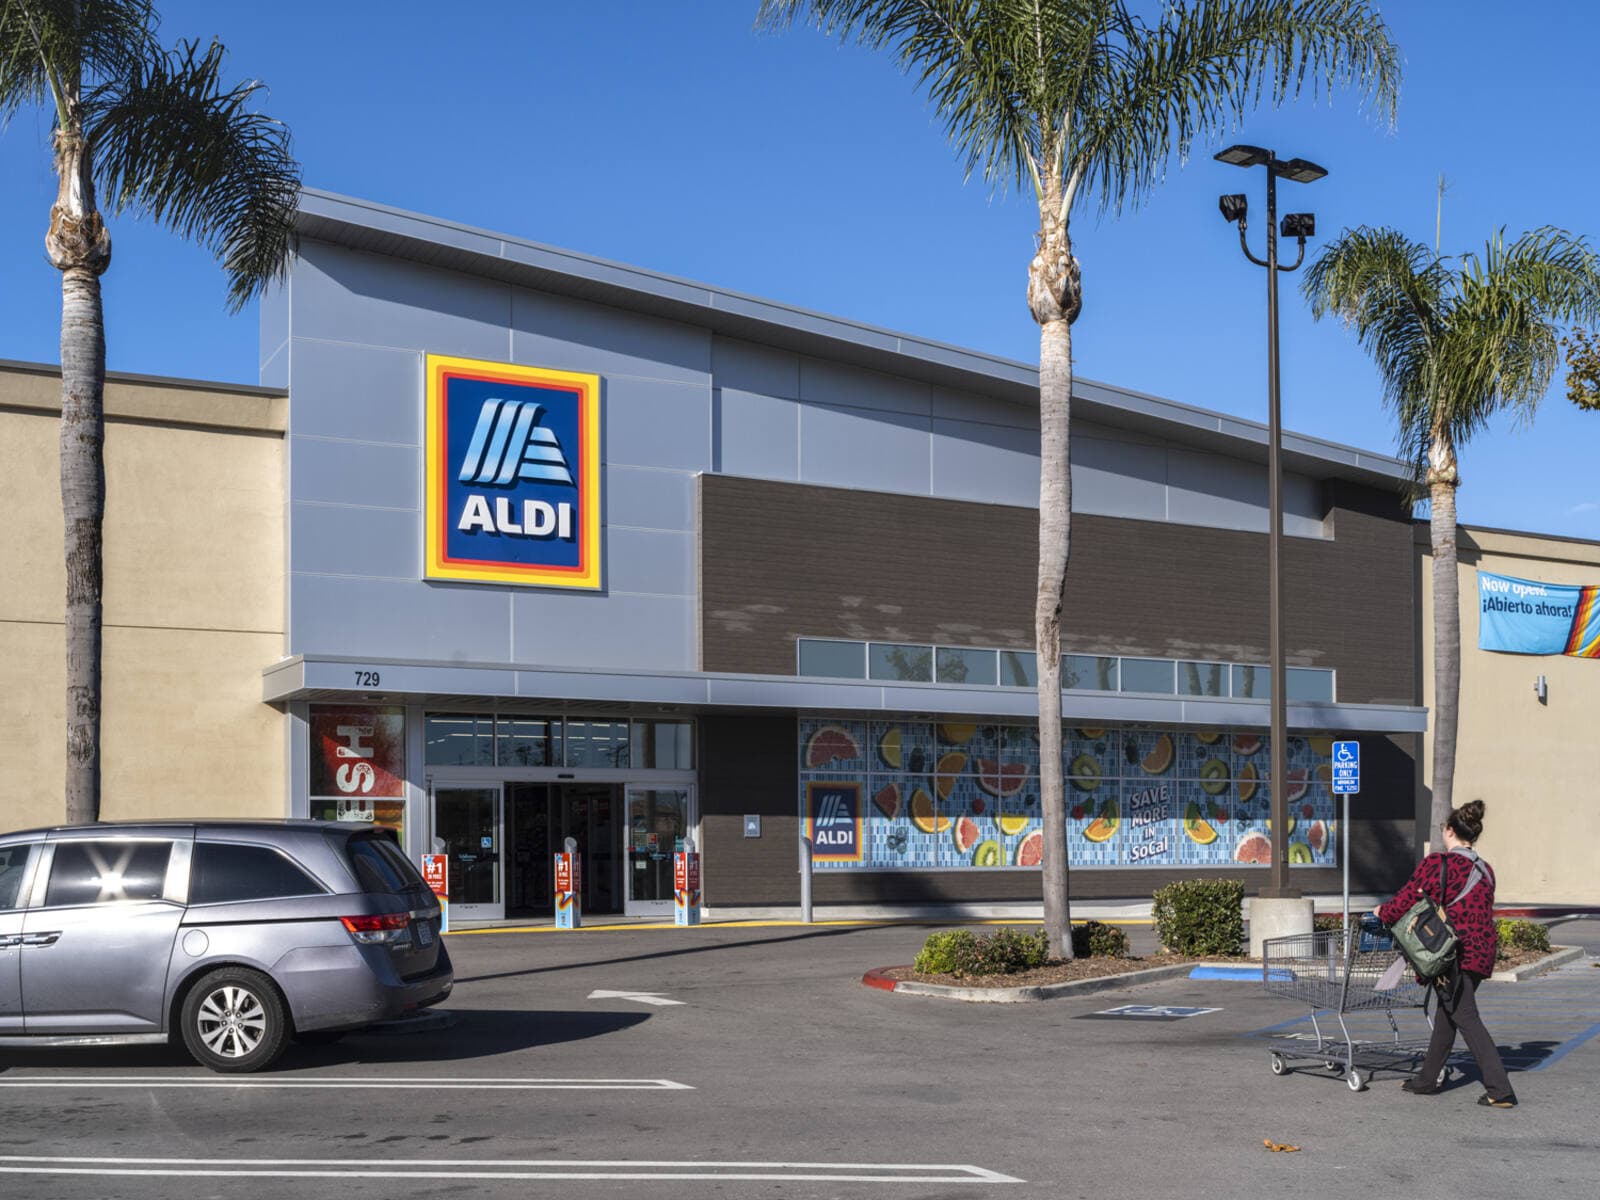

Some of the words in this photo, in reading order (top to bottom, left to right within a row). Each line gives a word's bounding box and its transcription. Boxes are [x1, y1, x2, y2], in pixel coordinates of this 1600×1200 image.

[458, 495, 571, 538] ALDI
[1482, 577, 1509, 592] Now
[1483, 597, 1533, 615] ¡Abierto
[1535, 601, 1573, 618] ahora!
[355, 671, 380, 687] 729
[1334, 761, 1358, 769] PARKING
[1339, 769, 1353, 777] ONLY
[1131, 785, 1168, 809] SAVE
[1131, 805, 1168, 828] MORE
[816, 831, 853, 845] ALDI
[1144, 827, 1155, 839] IN
[1131, 836, 1168, 862] SoCal
[426, 862, 443, 874] #1
[557, 860, 569, 872] #1
